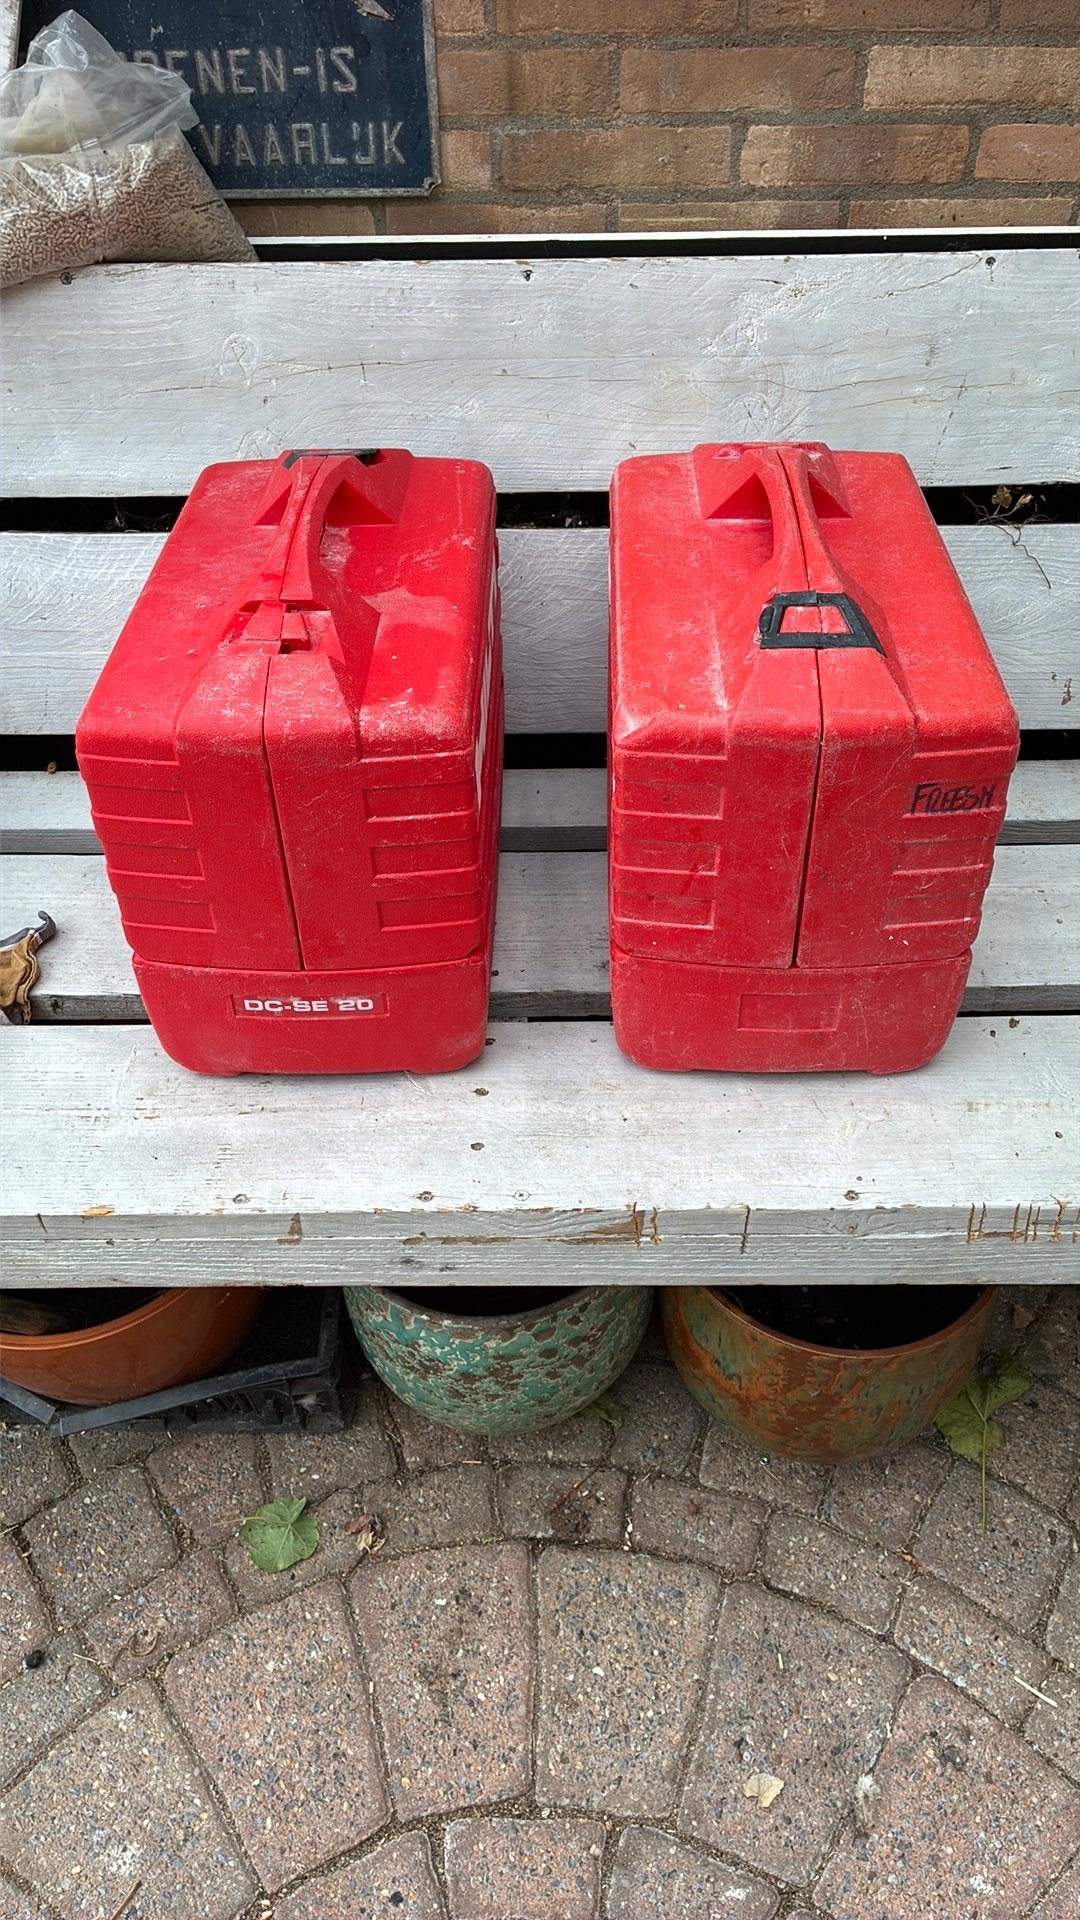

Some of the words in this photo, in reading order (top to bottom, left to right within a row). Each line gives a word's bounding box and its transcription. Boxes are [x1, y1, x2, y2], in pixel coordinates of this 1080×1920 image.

[197, 121, 406, 166] VAARLIJK
[243, 999, 329, 1012] DC-SE
[338, 998, 374, 1011] 20
